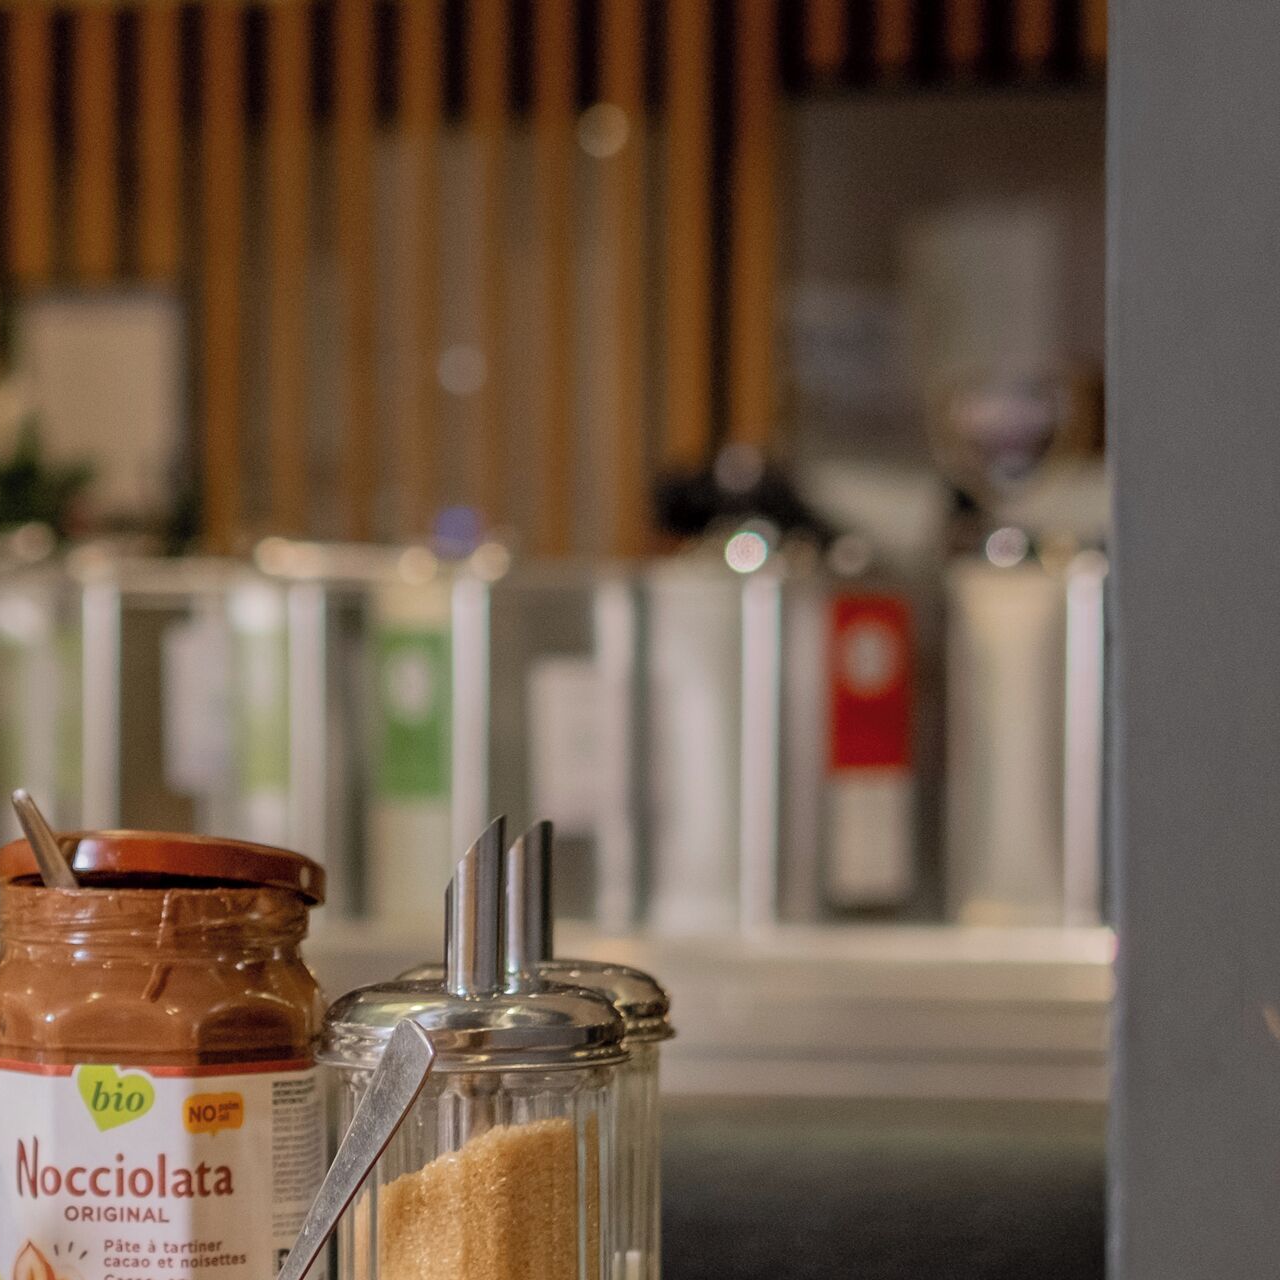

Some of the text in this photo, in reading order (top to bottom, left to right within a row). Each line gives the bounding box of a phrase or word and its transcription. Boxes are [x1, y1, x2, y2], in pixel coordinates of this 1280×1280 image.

[92, 1081, 145, 1112] bio
[188, 1105, 217, 1123] NO
[16, 1135, 235, 1200] Nocciolata
[64, 1205, 170, 1223] ORIGINAL
[103, 1239, 223, 1254] Pâte à tartiner
[103, 1253, 247, 1269] cacao et noisettes
